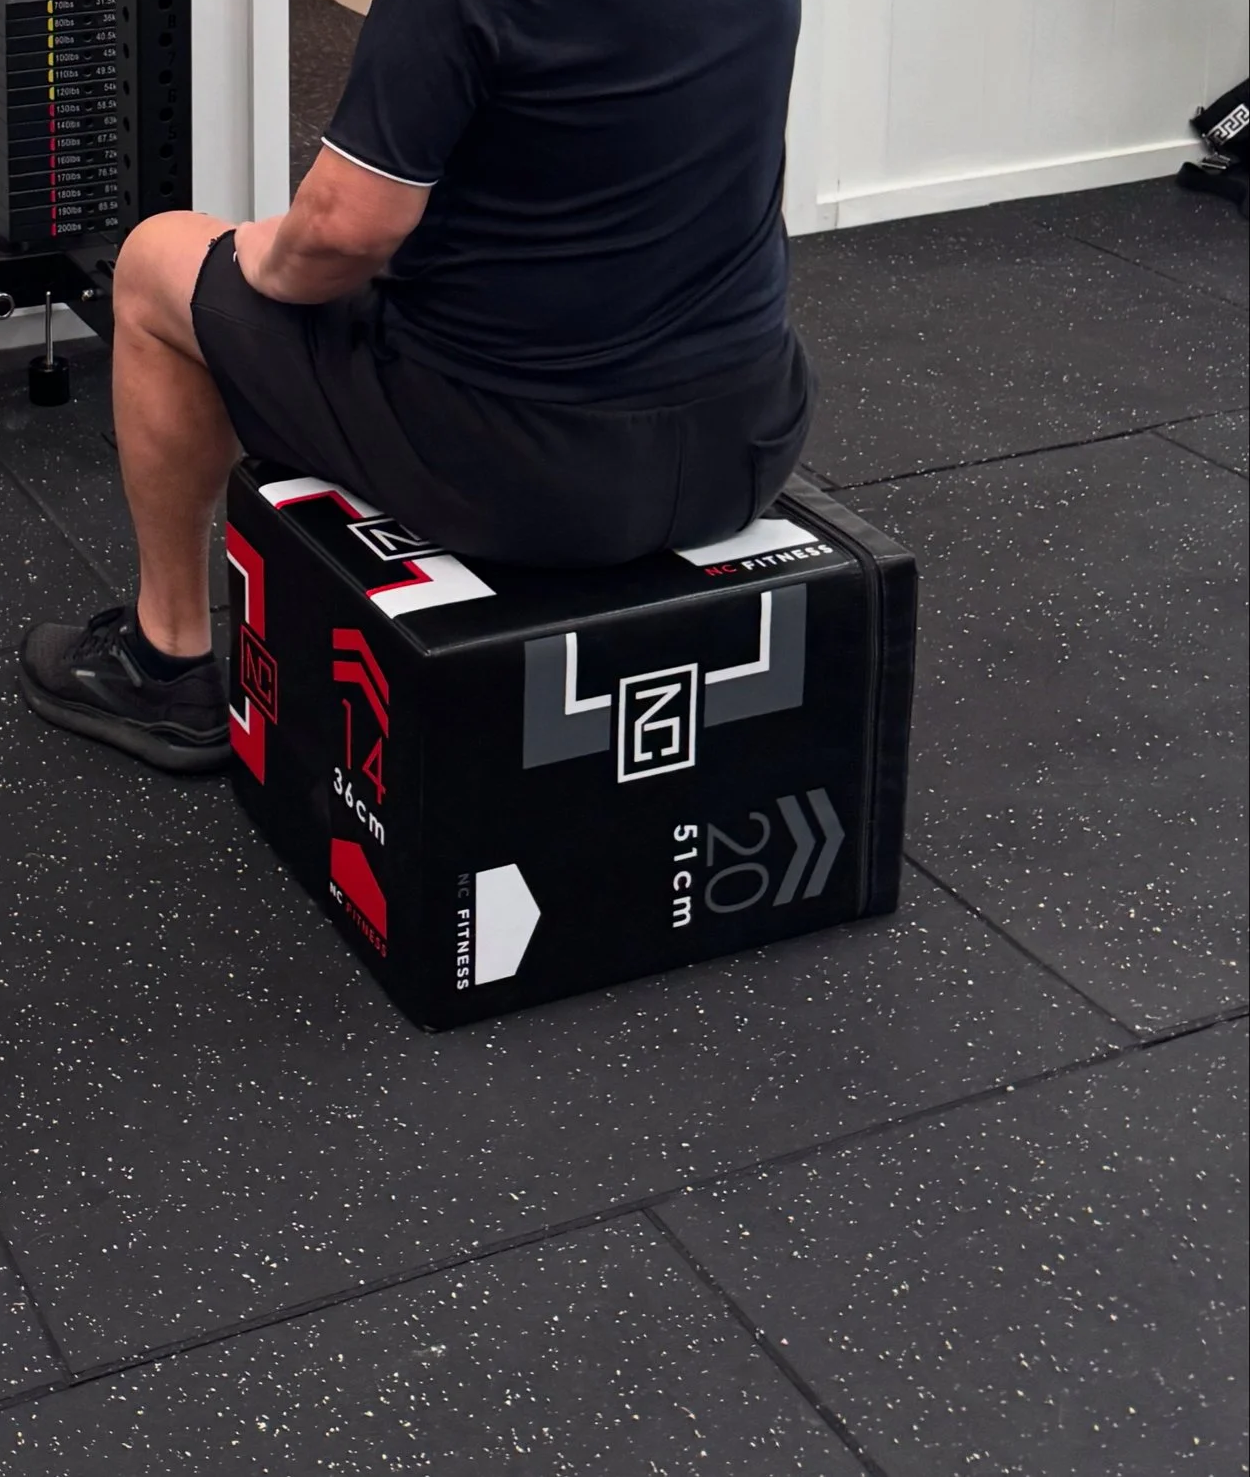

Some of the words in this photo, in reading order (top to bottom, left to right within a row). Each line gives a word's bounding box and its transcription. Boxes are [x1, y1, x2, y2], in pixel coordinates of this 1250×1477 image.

[706, 562, 737, 577] NC
[742, 542, 833, 571] FITNESS
[246, 642, 273, 706] NC
[341, 697, 388, 806] 14
[633, 680, 686, 762] NC
[333, 766, 386, 846] 36cm
[456, 871, 469, 900] NC
[672, 822, 699, 929] 51cm
[706, 812, 771, 915] 20
[329, 881, 344, 905] NC
[345, 892, 388, 959] FITNESS
[456, 908, 469, 990] FITNESS
